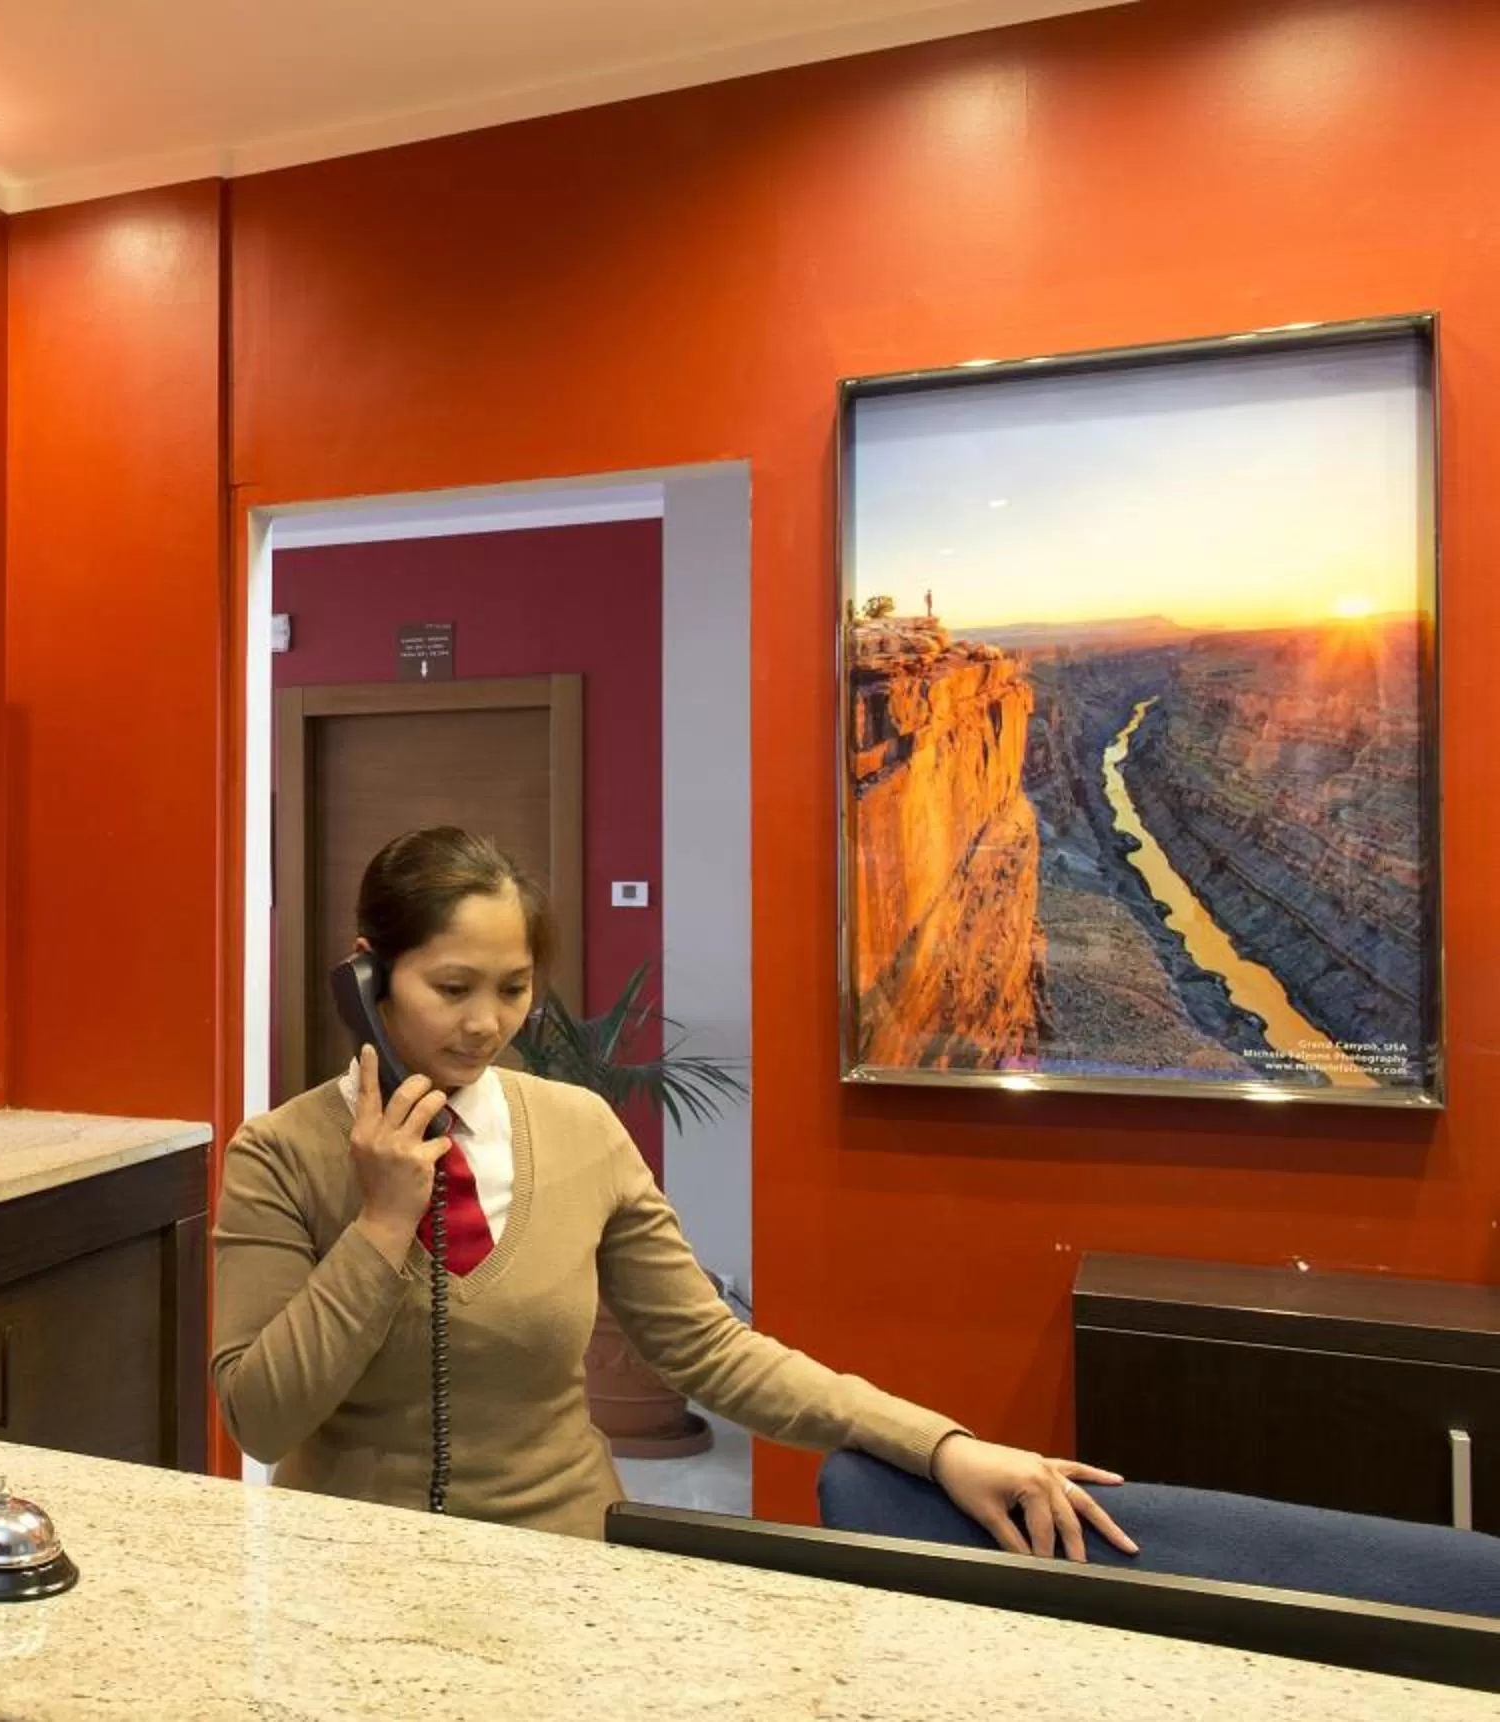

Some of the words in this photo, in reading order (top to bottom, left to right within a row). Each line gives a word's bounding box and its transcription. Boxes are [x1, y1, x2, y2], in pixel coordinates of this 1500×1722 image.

[1298, 1039, 1333, 1050] Grand
[1335, 1041, 1381, 1052] Canyon,
[1383, 1043, 1408, 1052] USA
[1332, 1052, 1408, 1065] Photography
